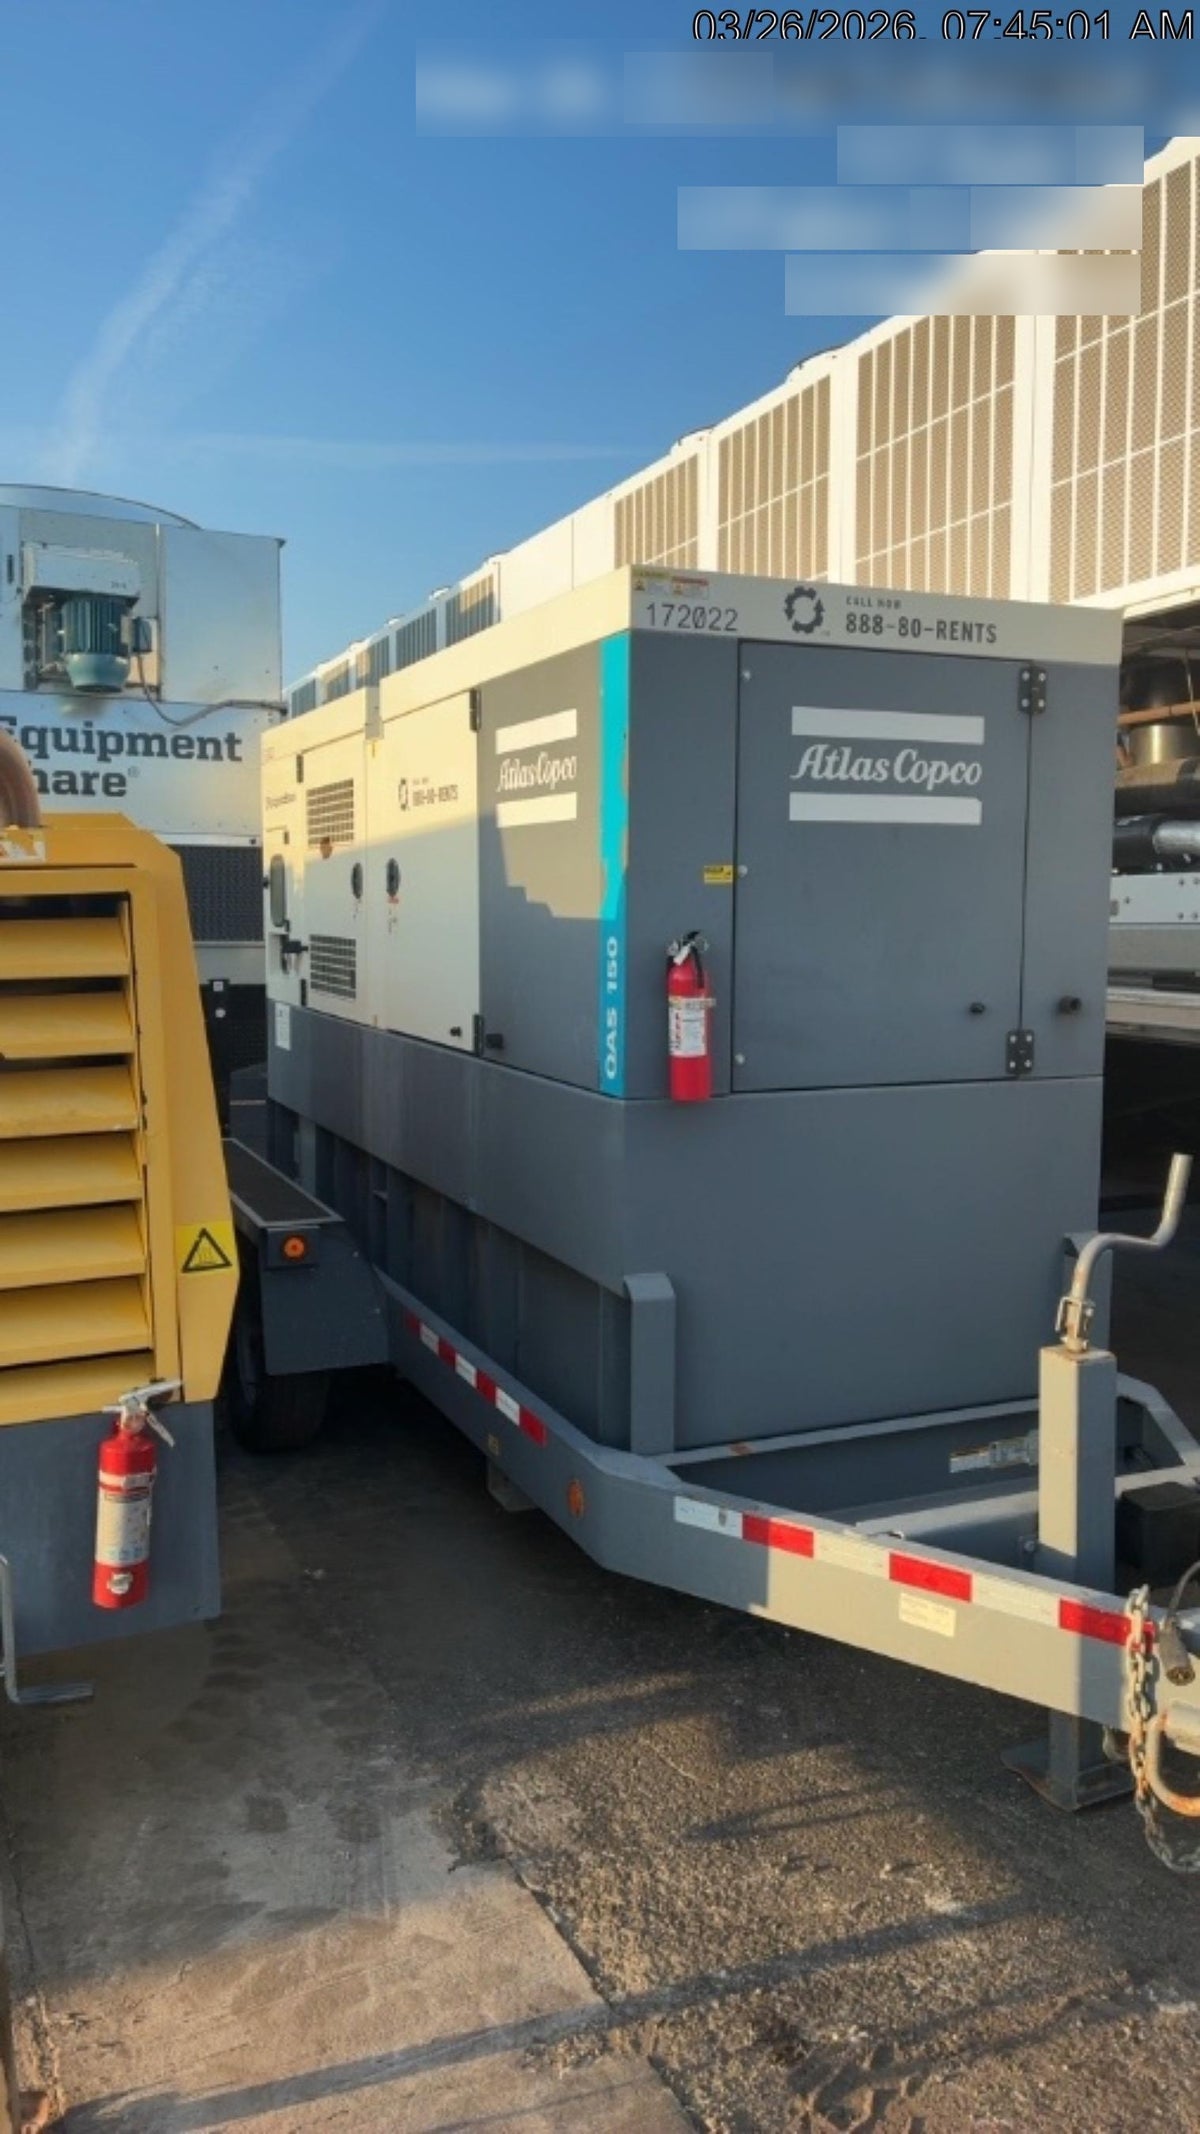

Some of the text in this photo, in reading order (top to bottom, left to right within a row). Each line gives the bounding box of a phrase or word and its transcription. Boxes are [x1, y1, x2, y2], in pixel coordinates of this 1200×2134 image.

[645, 602, 739, 631] 172022
[845, 612, 998, 644] 888-80-RENTS
[496, 751, 577, 792] Atlas Copco
[789, 744, 983, 791] Atlas Copco
[606, 936, 618, 994] 150
